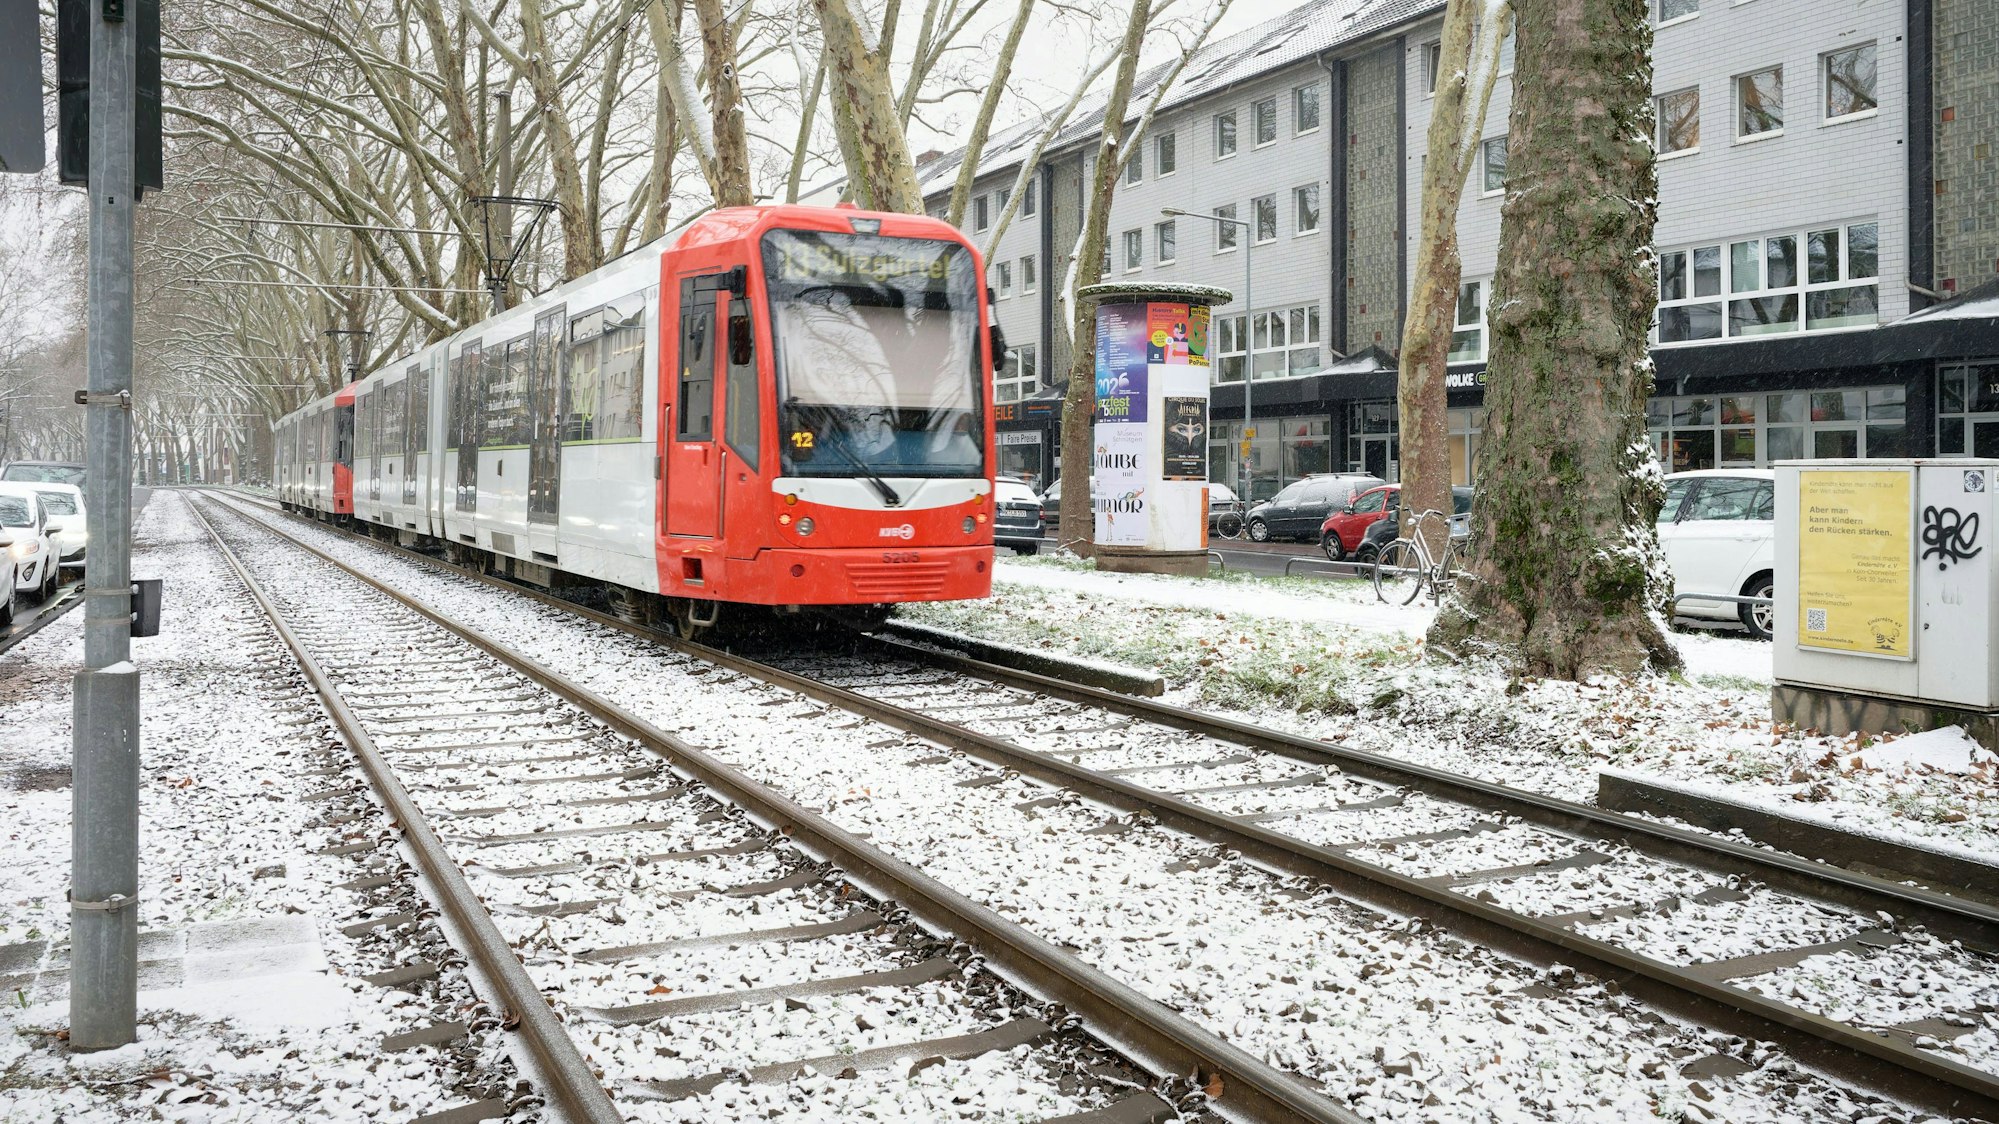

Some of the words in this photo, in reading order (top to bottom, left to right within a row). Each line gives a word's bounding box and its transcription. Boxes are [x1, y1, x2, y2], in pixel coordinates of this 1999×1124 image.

[784, 243, 811, 278] 13
[1097, 372, 1130, 395] 2026
[1104, 406, 1128, 416] bonn
[791, 432, 814, 448] 12
[1008, 434, 1020, 443] Faire
[1809, 506, 1829, 514] Aber
[1832, 517, 1863, 525] Kindern
[1826, 526, 1856, 535] Rücken
[1858, 528, 1893, 537] stärken.
[882, 552, 920, 564] 5205
